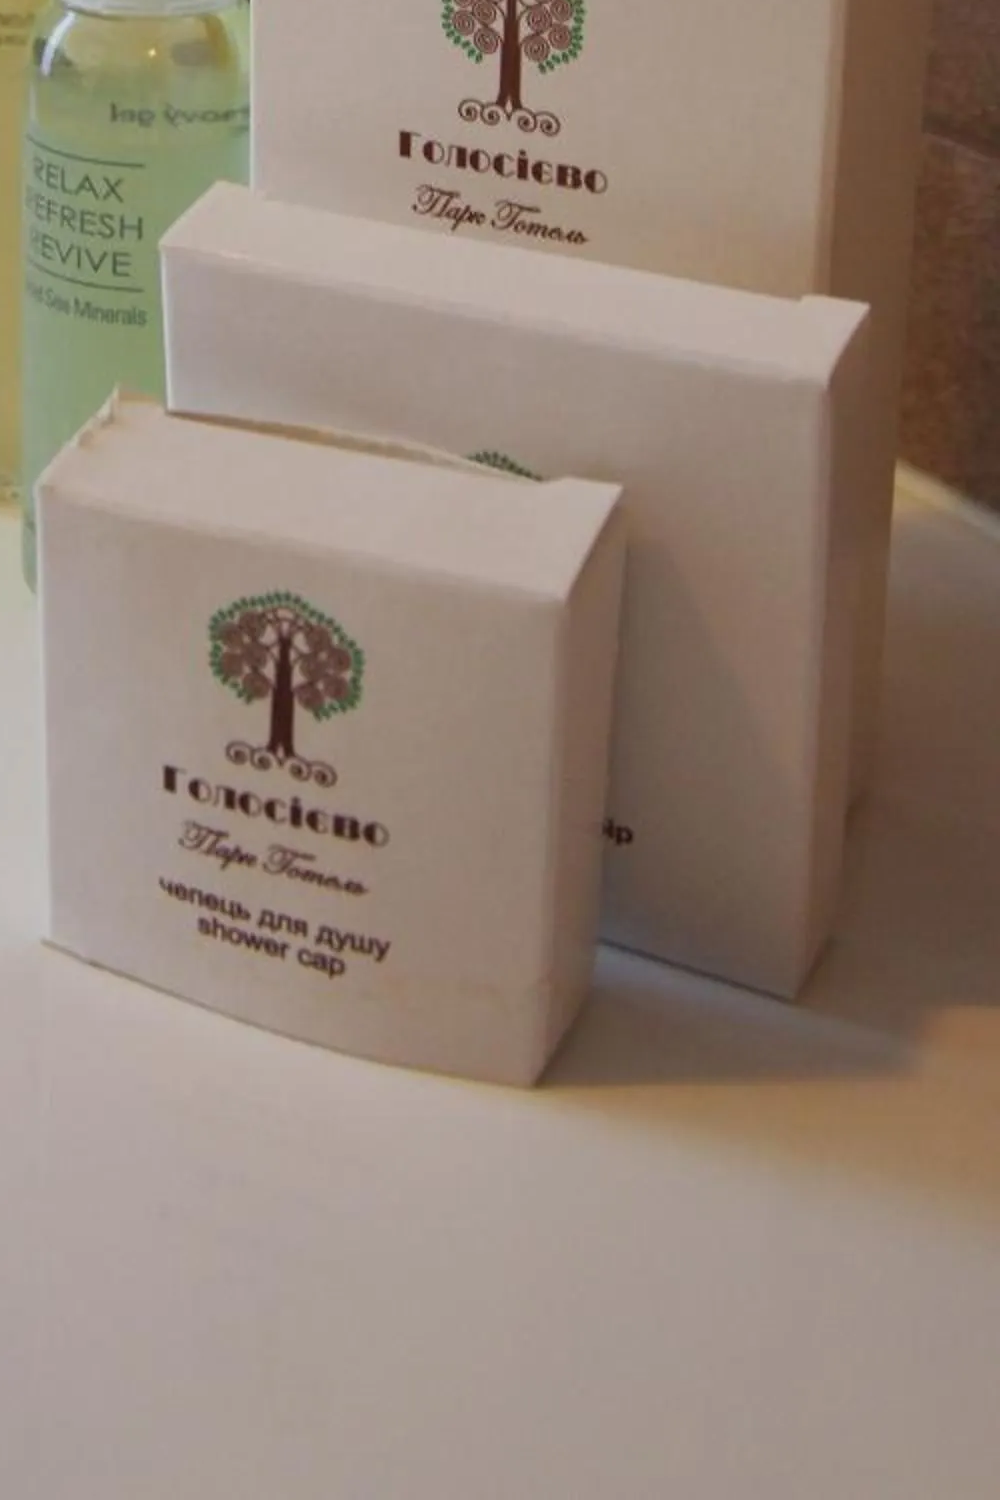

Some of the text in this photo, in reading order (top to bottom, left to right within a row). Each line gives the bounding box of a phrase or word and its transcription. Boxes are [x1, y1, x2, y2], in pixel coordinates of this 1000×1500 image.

[33, 155, 124, 204] RELAX
[398, 130, 608, 194] Голосієво
[412, 184, 589, 245] Парк Готель
[73, 296, 148, 326] Minerals
[162, 764, 391, 848] Голосієво
[178, 820, 369, 896] Парк Готель
[158, 876, 392, 963] чепець для душу
[197, 916, 346, 980] shower cap
